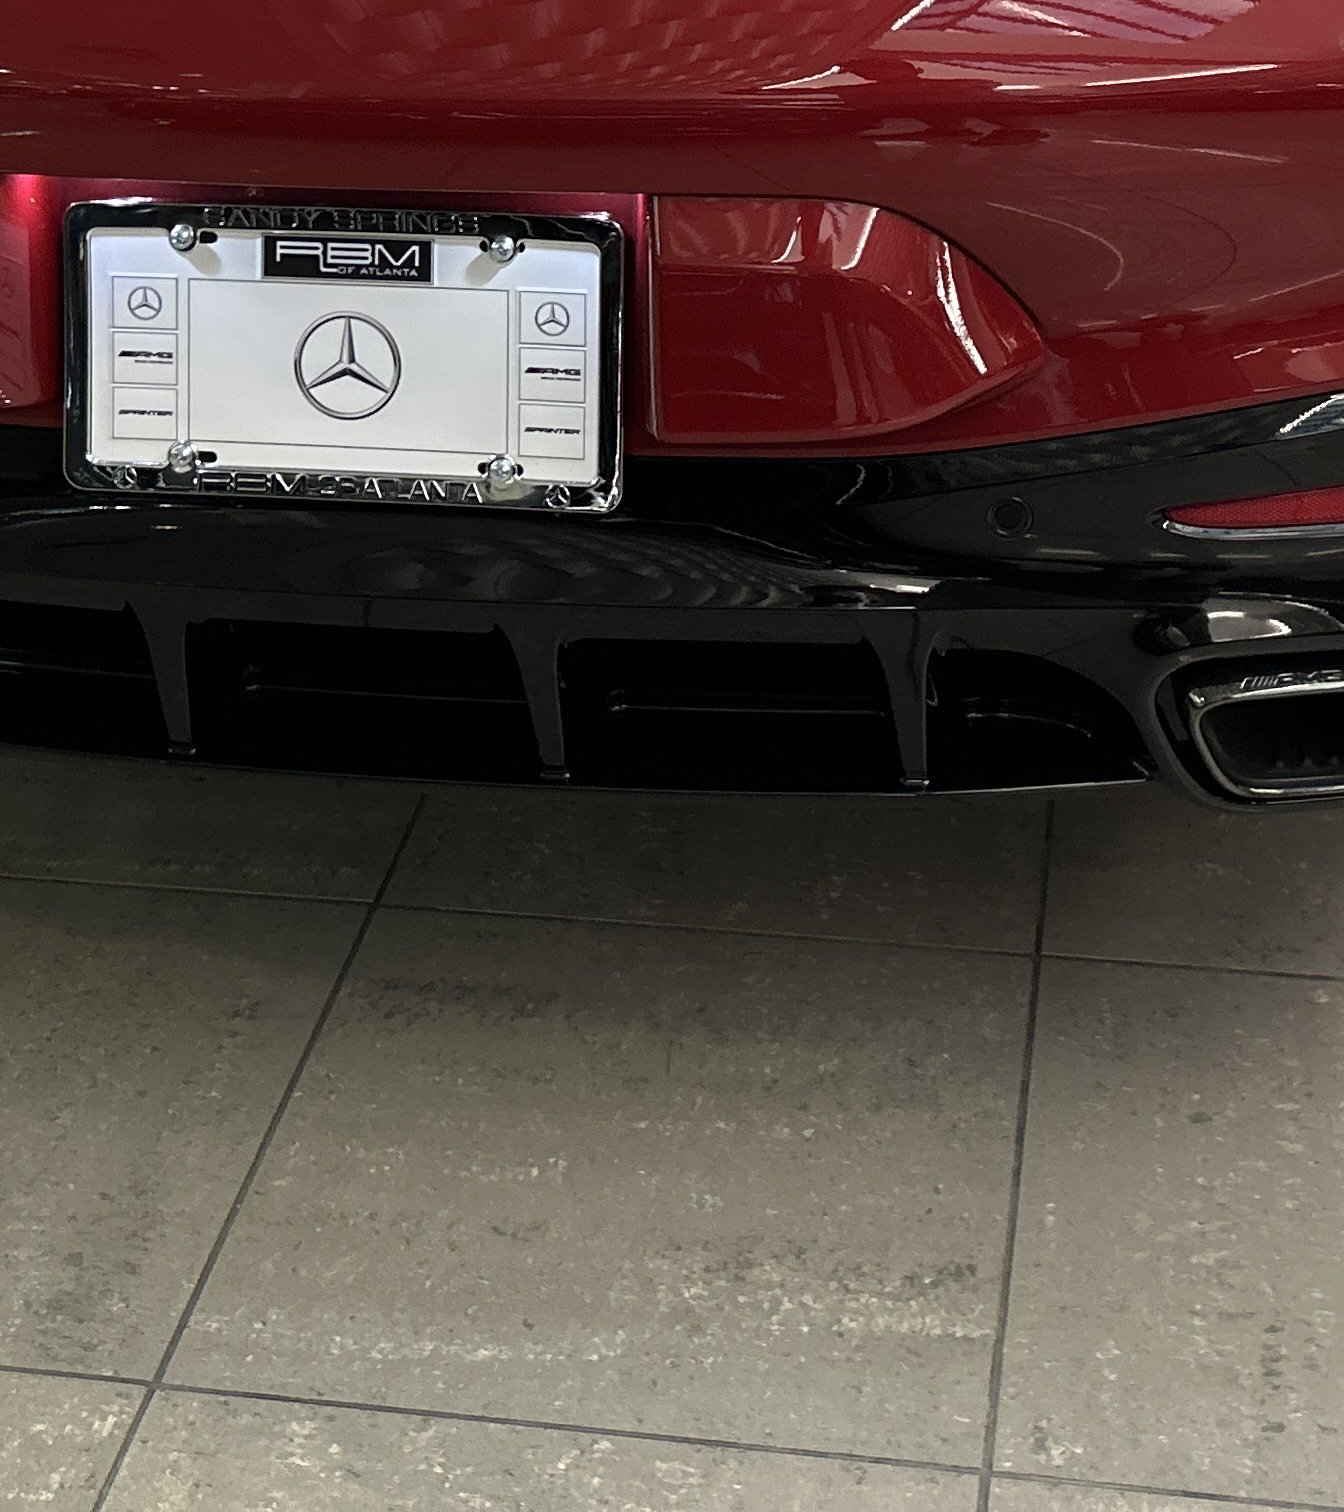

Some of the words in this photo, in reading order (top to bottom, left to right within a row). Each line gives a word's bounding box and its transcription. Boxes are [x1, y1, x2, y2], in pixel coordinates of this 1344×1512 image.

[205, 208, 321, 230] SANDY
[333, 211, 480, 235] SPRINGS
[275, 240, 420, 272] RBM
[336, 266, 355, 275] OF
[360, 266, 418, 277] ATLANTA
[198, 471, 307, 494] RBM
[364, 477, 483, 504] ATLANTA
